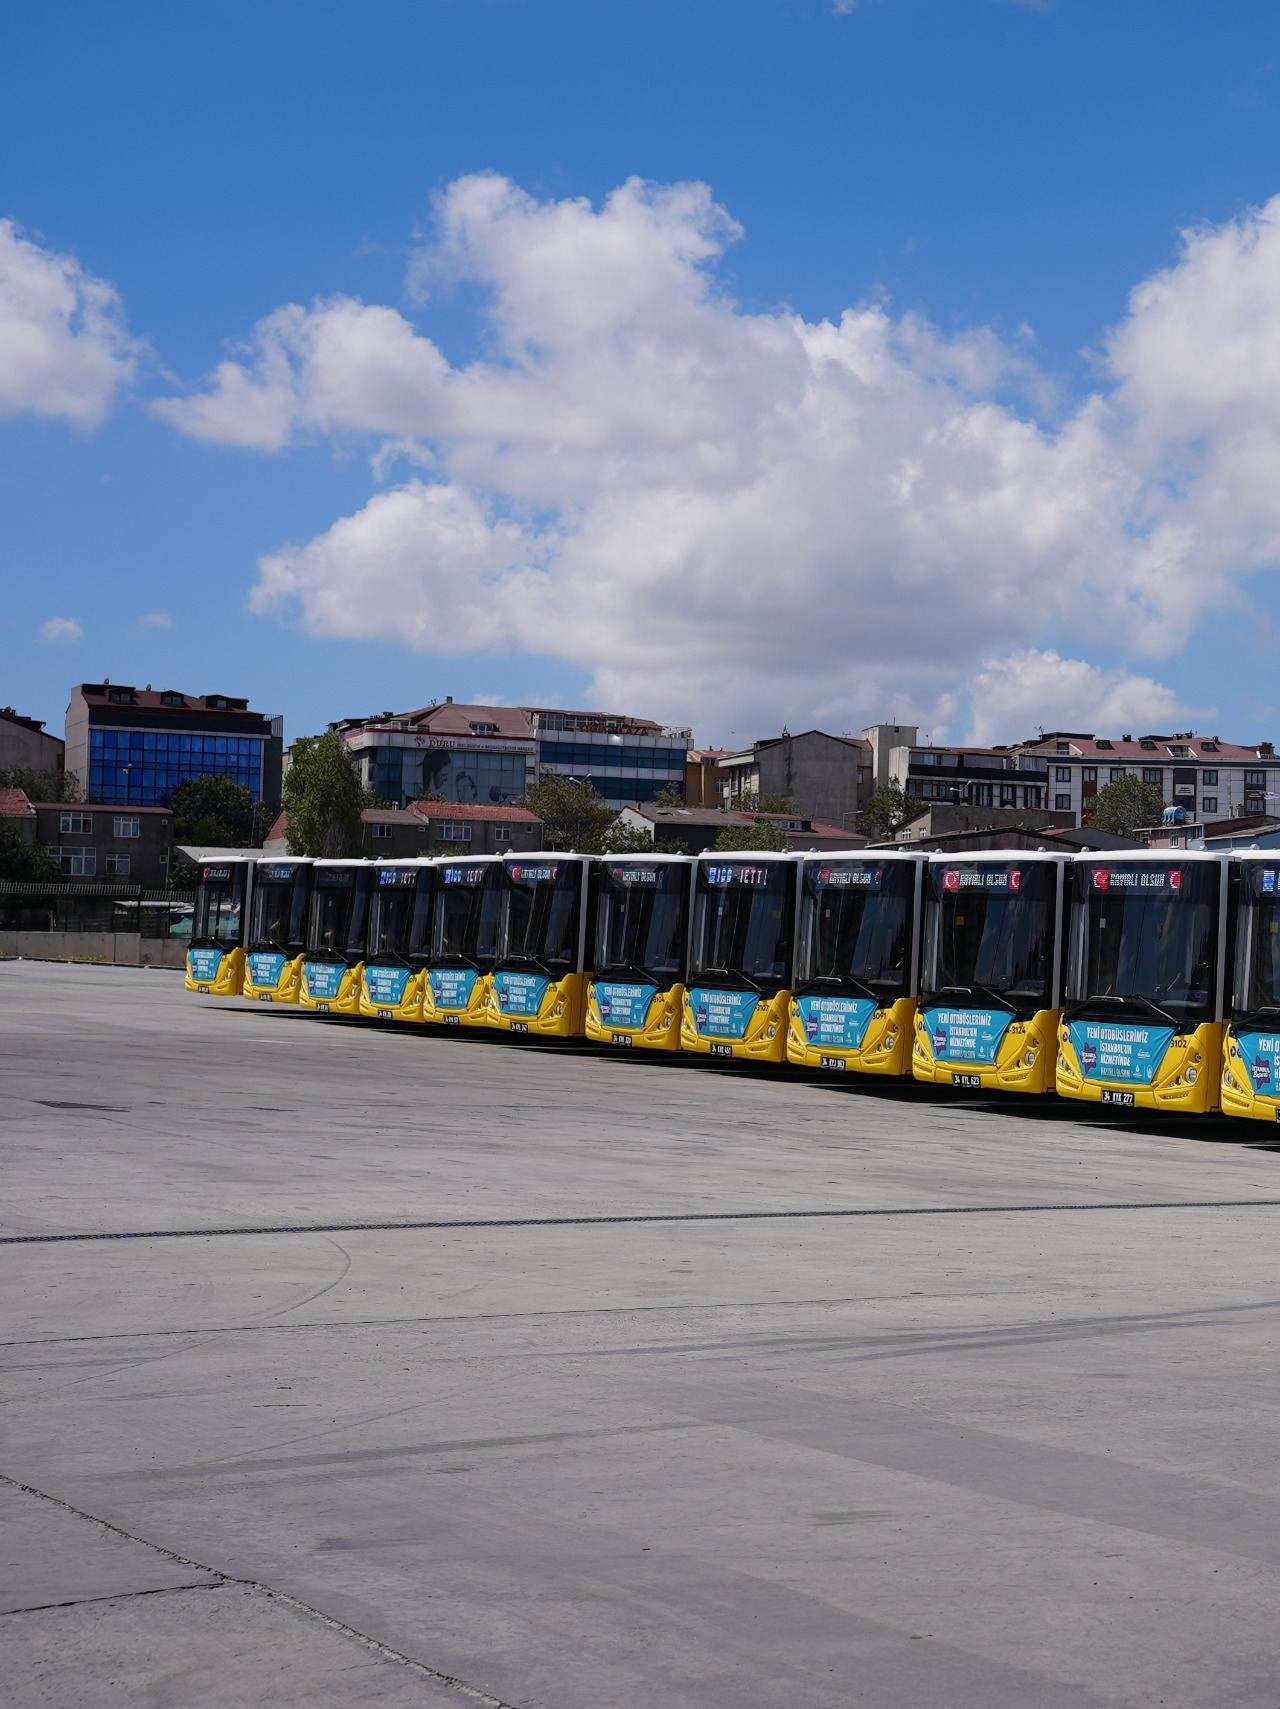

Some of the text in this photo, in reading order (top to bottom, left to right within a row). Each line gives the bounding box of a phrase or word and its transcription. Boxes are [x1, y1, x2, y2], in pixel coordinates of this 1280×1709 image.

[429, 740, 456, 748] DURU
[1086, 1026, 1148, 1043] YENİ OTOBÜSLERİMİZ
[1170, 1040, 1187, 1048] 3102
[1258, 1037, 1274, 1052] YENİ
